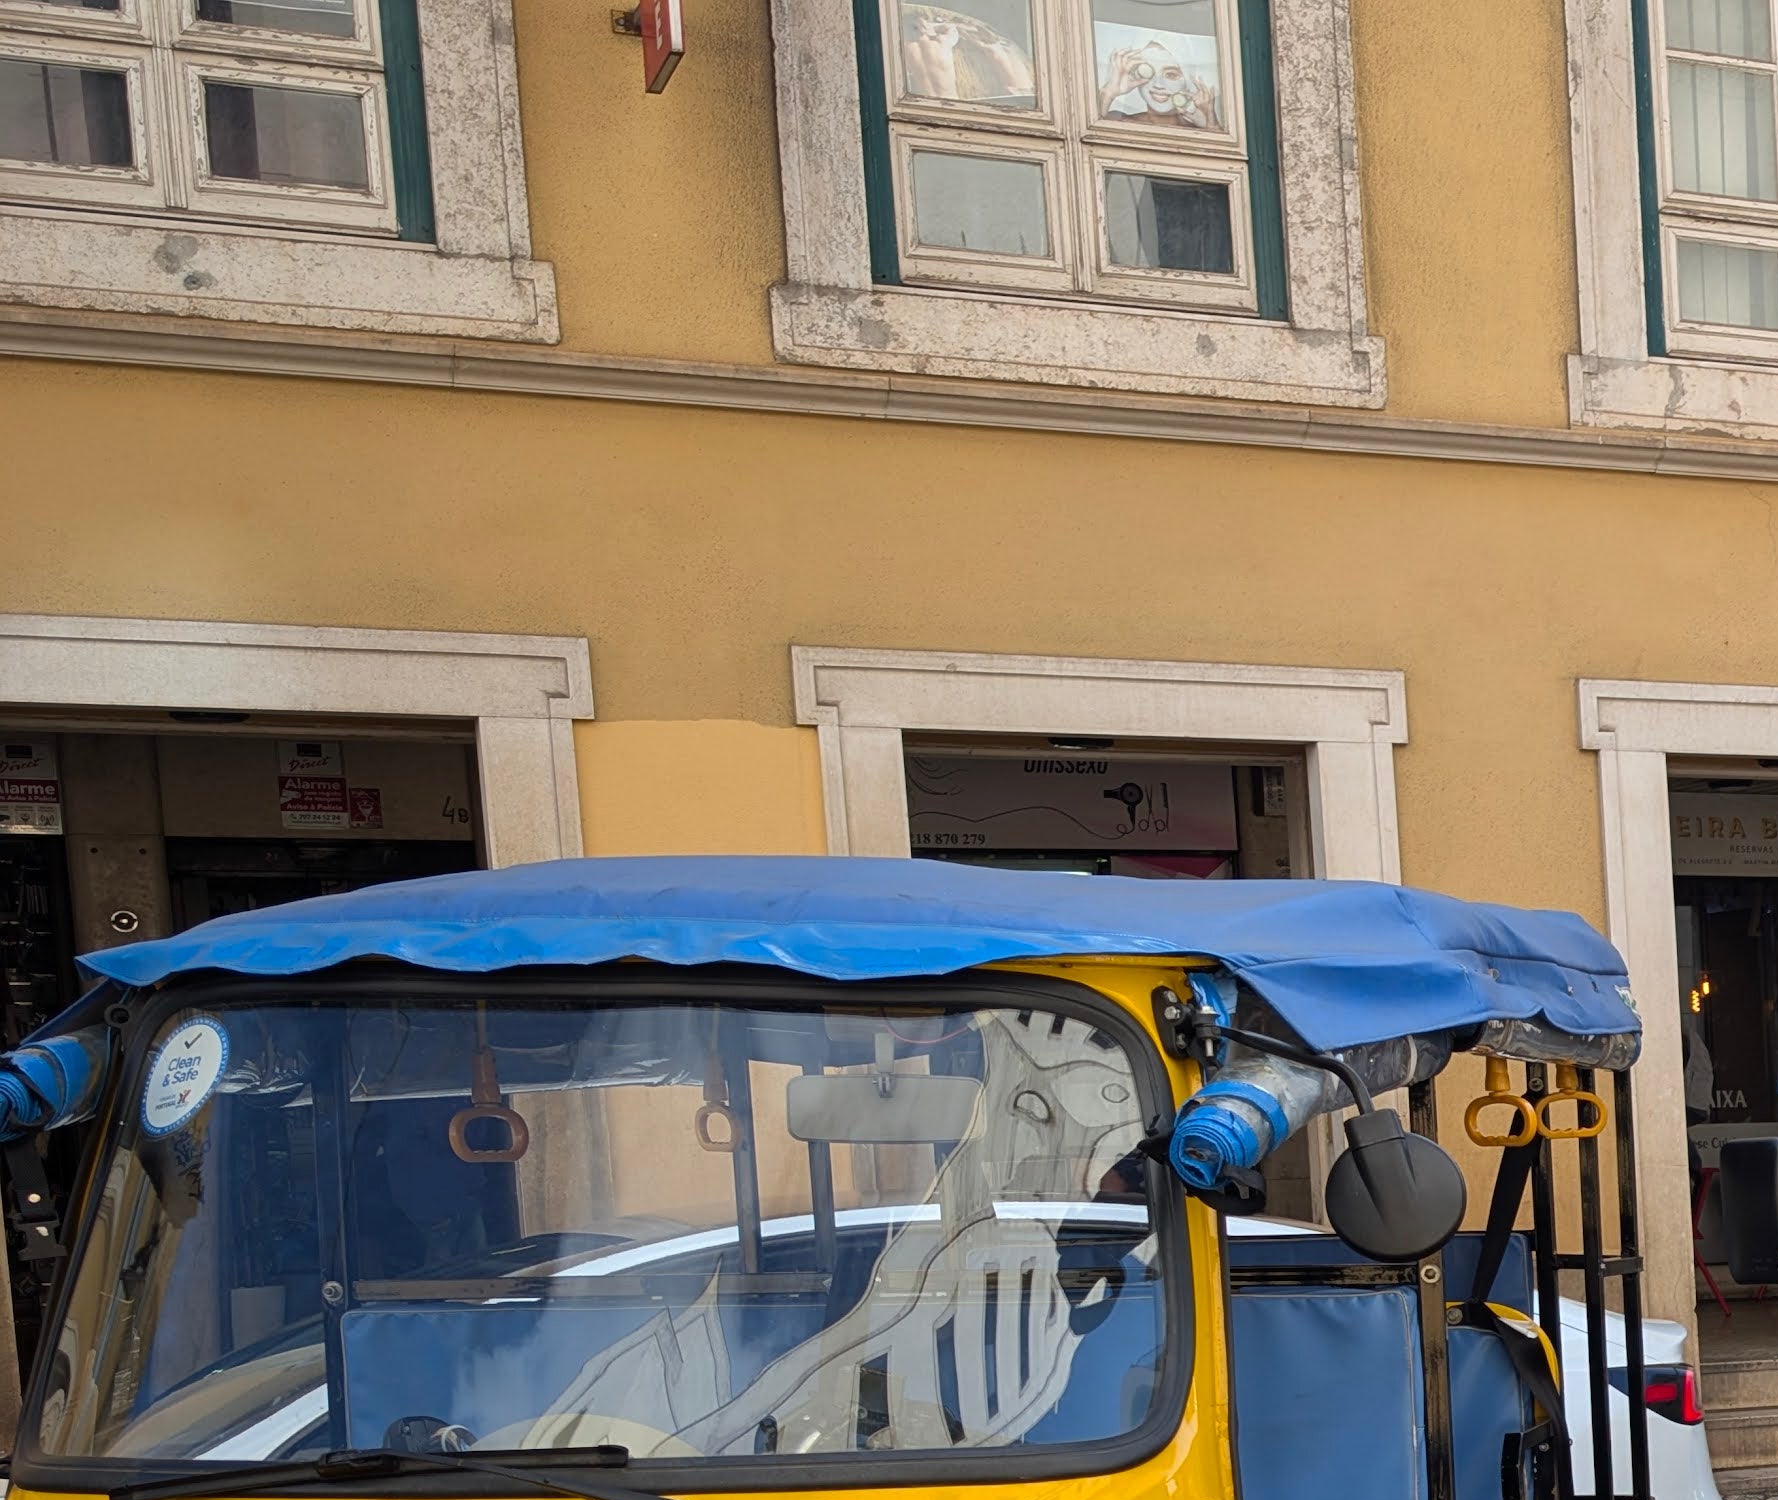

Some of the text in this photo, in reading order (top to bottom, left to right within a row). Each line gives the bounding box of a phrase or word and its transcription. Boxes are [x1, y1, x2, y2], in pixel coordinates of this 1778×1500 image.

[287, 756, 332, 772] Direct
[285, 777, 341, 790] Alarme
[934, 833, 959, 845] 870
[963, 833, 986, 845] 279
[1729, 845, 1774, 854] RESERVAS
[168, 1055, 202, 1072] Clean
[162, 1067, 199, 1088] & Safe
